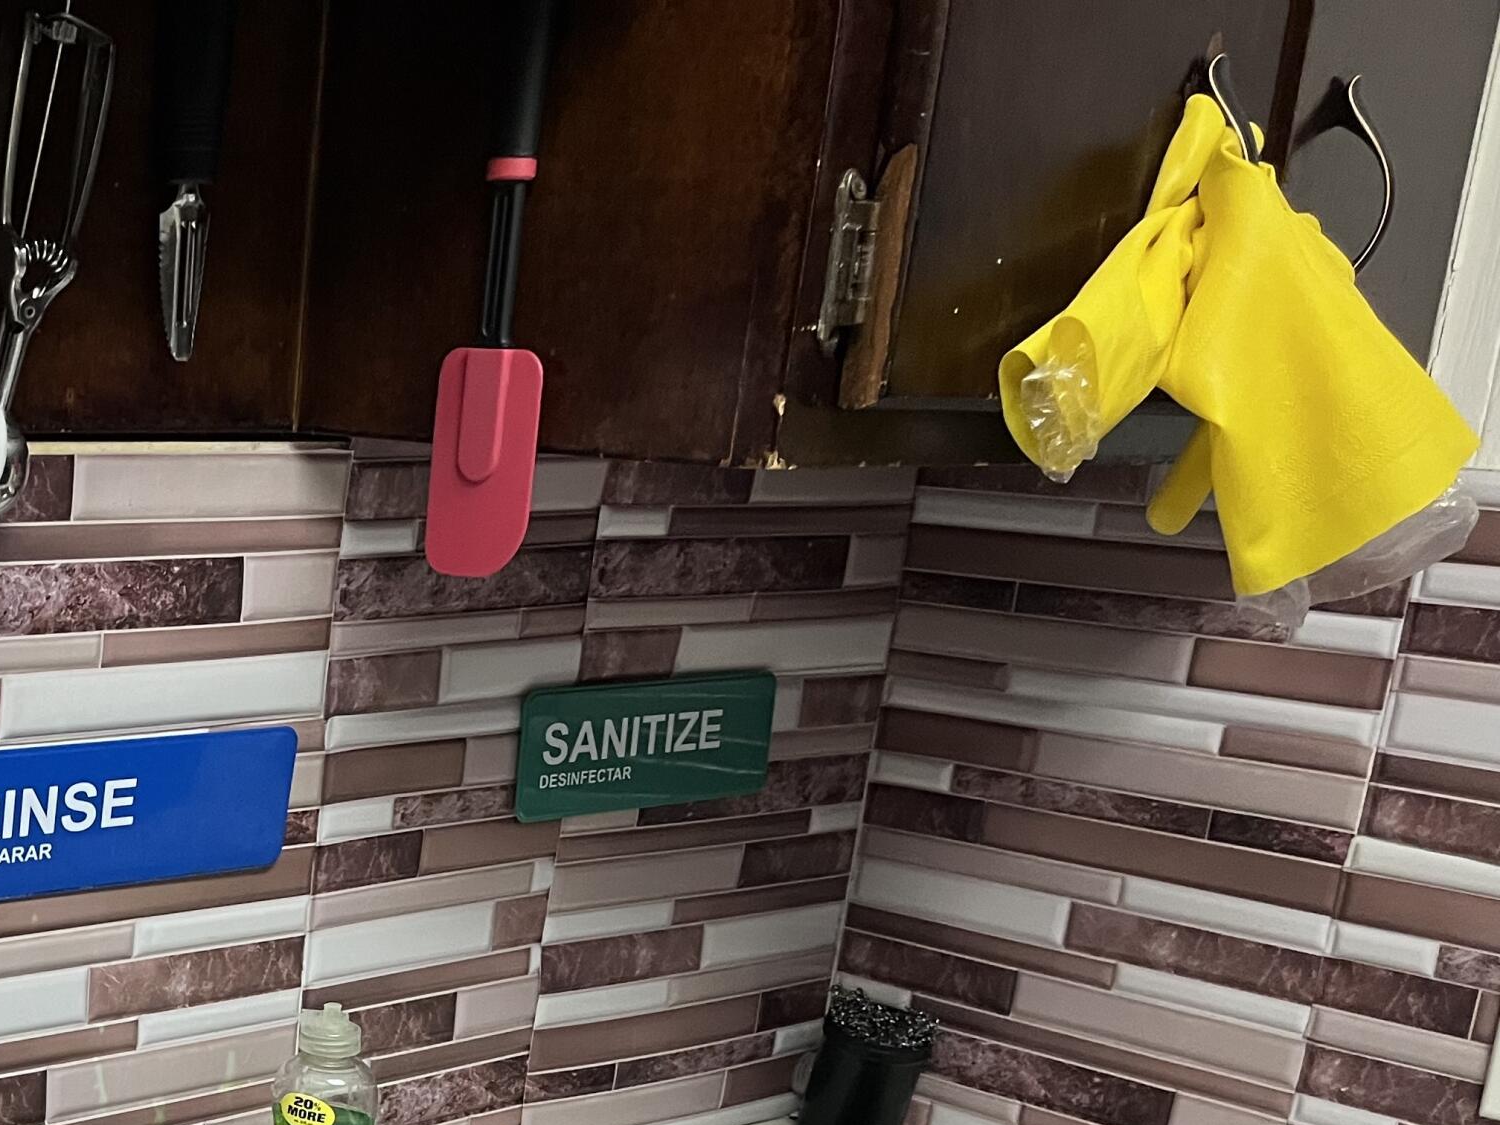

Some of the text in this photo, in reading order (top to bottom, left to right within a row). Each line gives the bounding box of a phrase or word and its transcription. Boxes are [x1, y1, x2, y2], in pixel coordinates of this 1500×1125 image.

[542, 709, 724, 766] SANITIZE
[539, 766, 632, 789] DESINFECTAR
[287, 1104, 327, 1124] MORE
